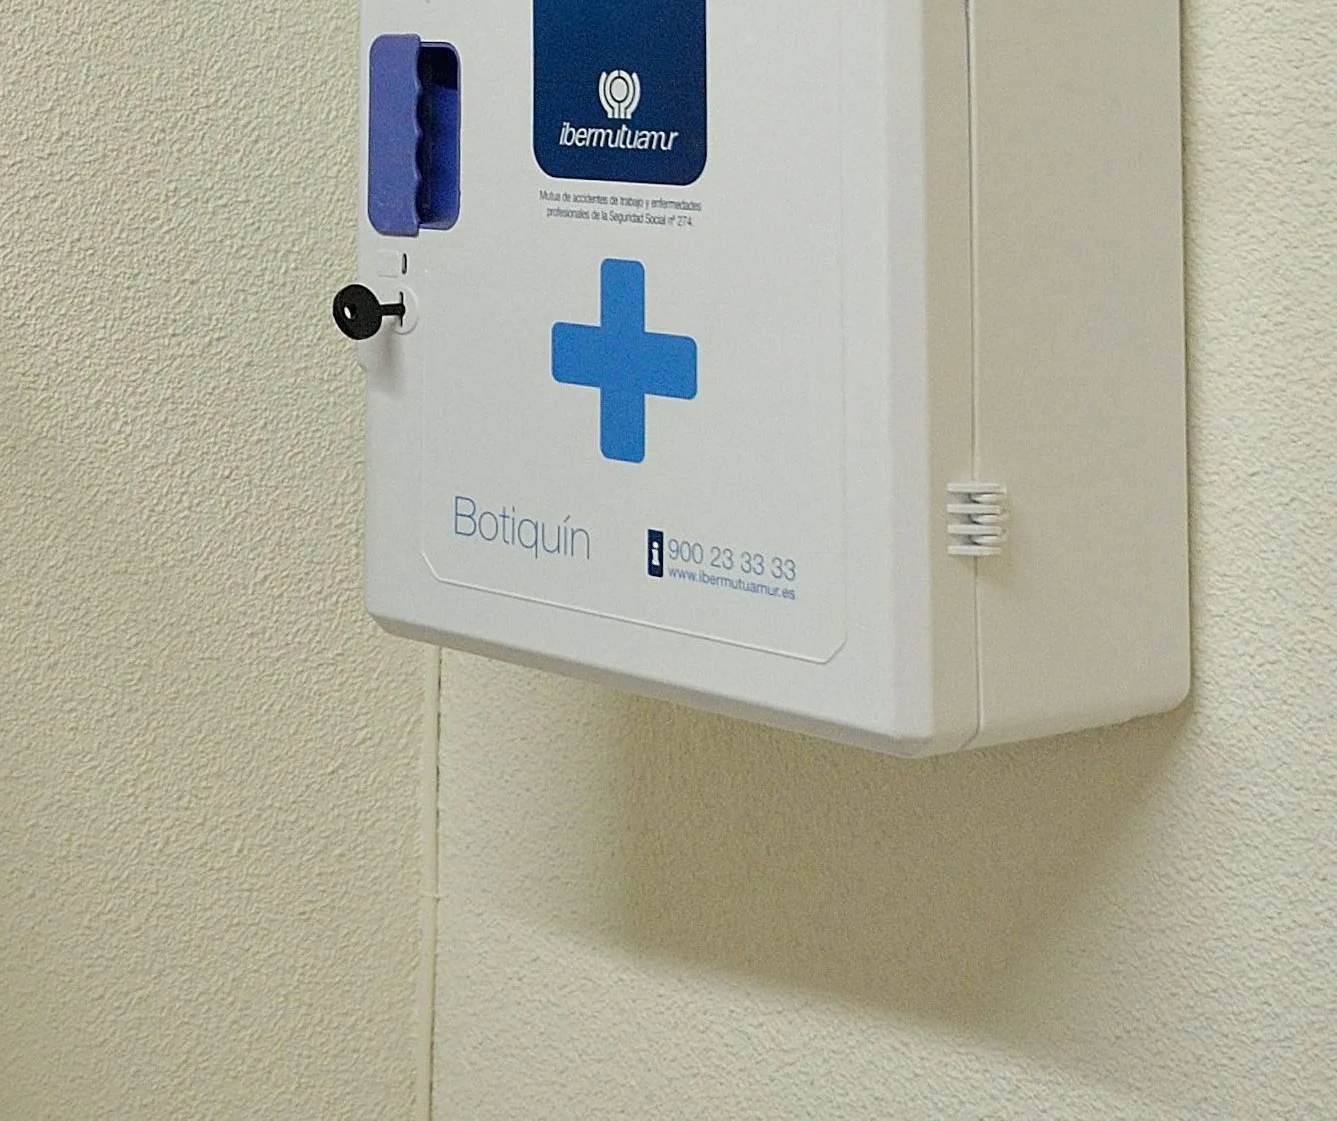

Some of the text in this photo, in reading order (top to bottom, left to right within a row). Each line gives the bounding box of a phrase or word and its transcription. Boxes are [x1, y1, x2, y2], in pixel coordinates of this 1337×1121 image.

[559, 122, 678, 150] ibermutuamur
[454, 495, 591, 560] Botiquín
[668, 539, 704, 564] 900
[710, 546, 734, 570] 23
[740, 551, 764, 576] 33
[771, 557, 796, 581] 33
[668, 567, 796, 600] www.ibermutuamur.es
